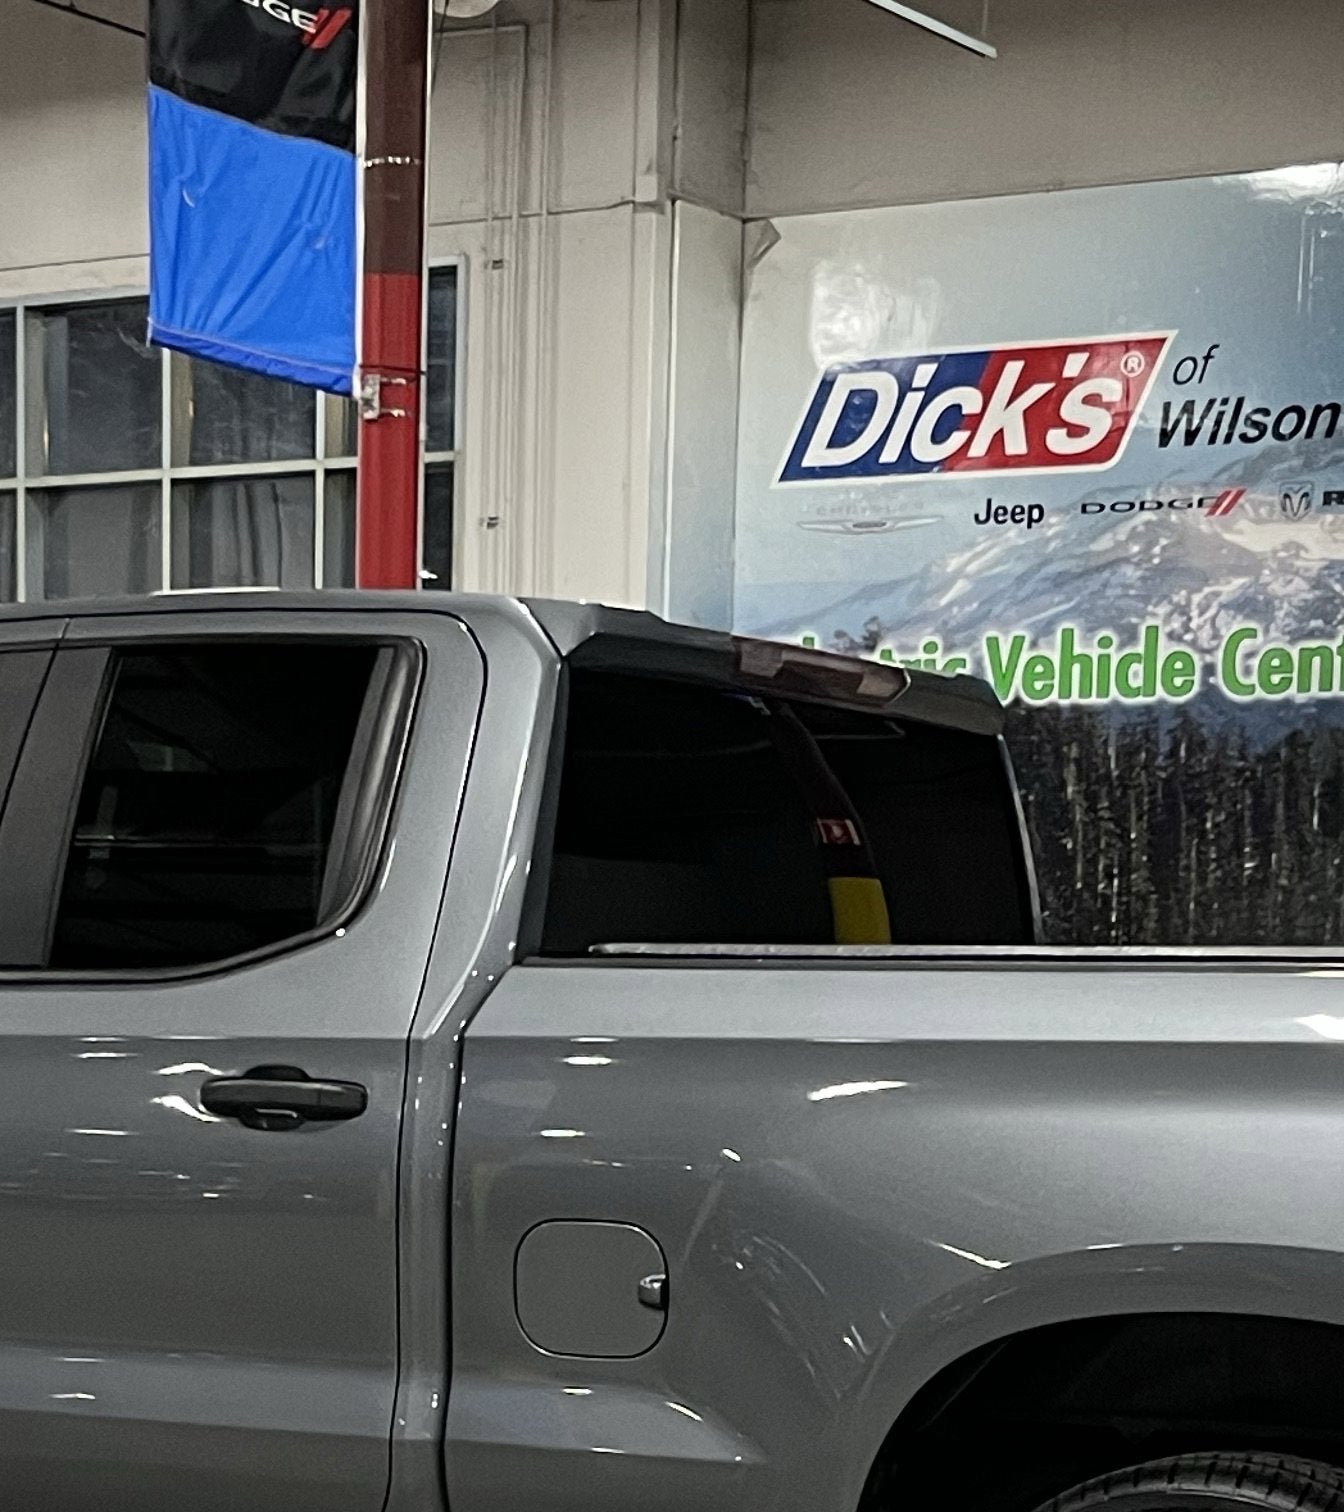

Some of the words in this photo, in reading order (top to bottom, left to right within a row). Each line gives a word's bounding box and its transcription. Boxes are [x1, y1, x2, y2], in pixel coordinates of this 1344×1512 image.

[1173, 345, 1220, 385] of
[975, 498, 1045, 529] Jeep
[986, 625, 1196, 701] Vehicle
